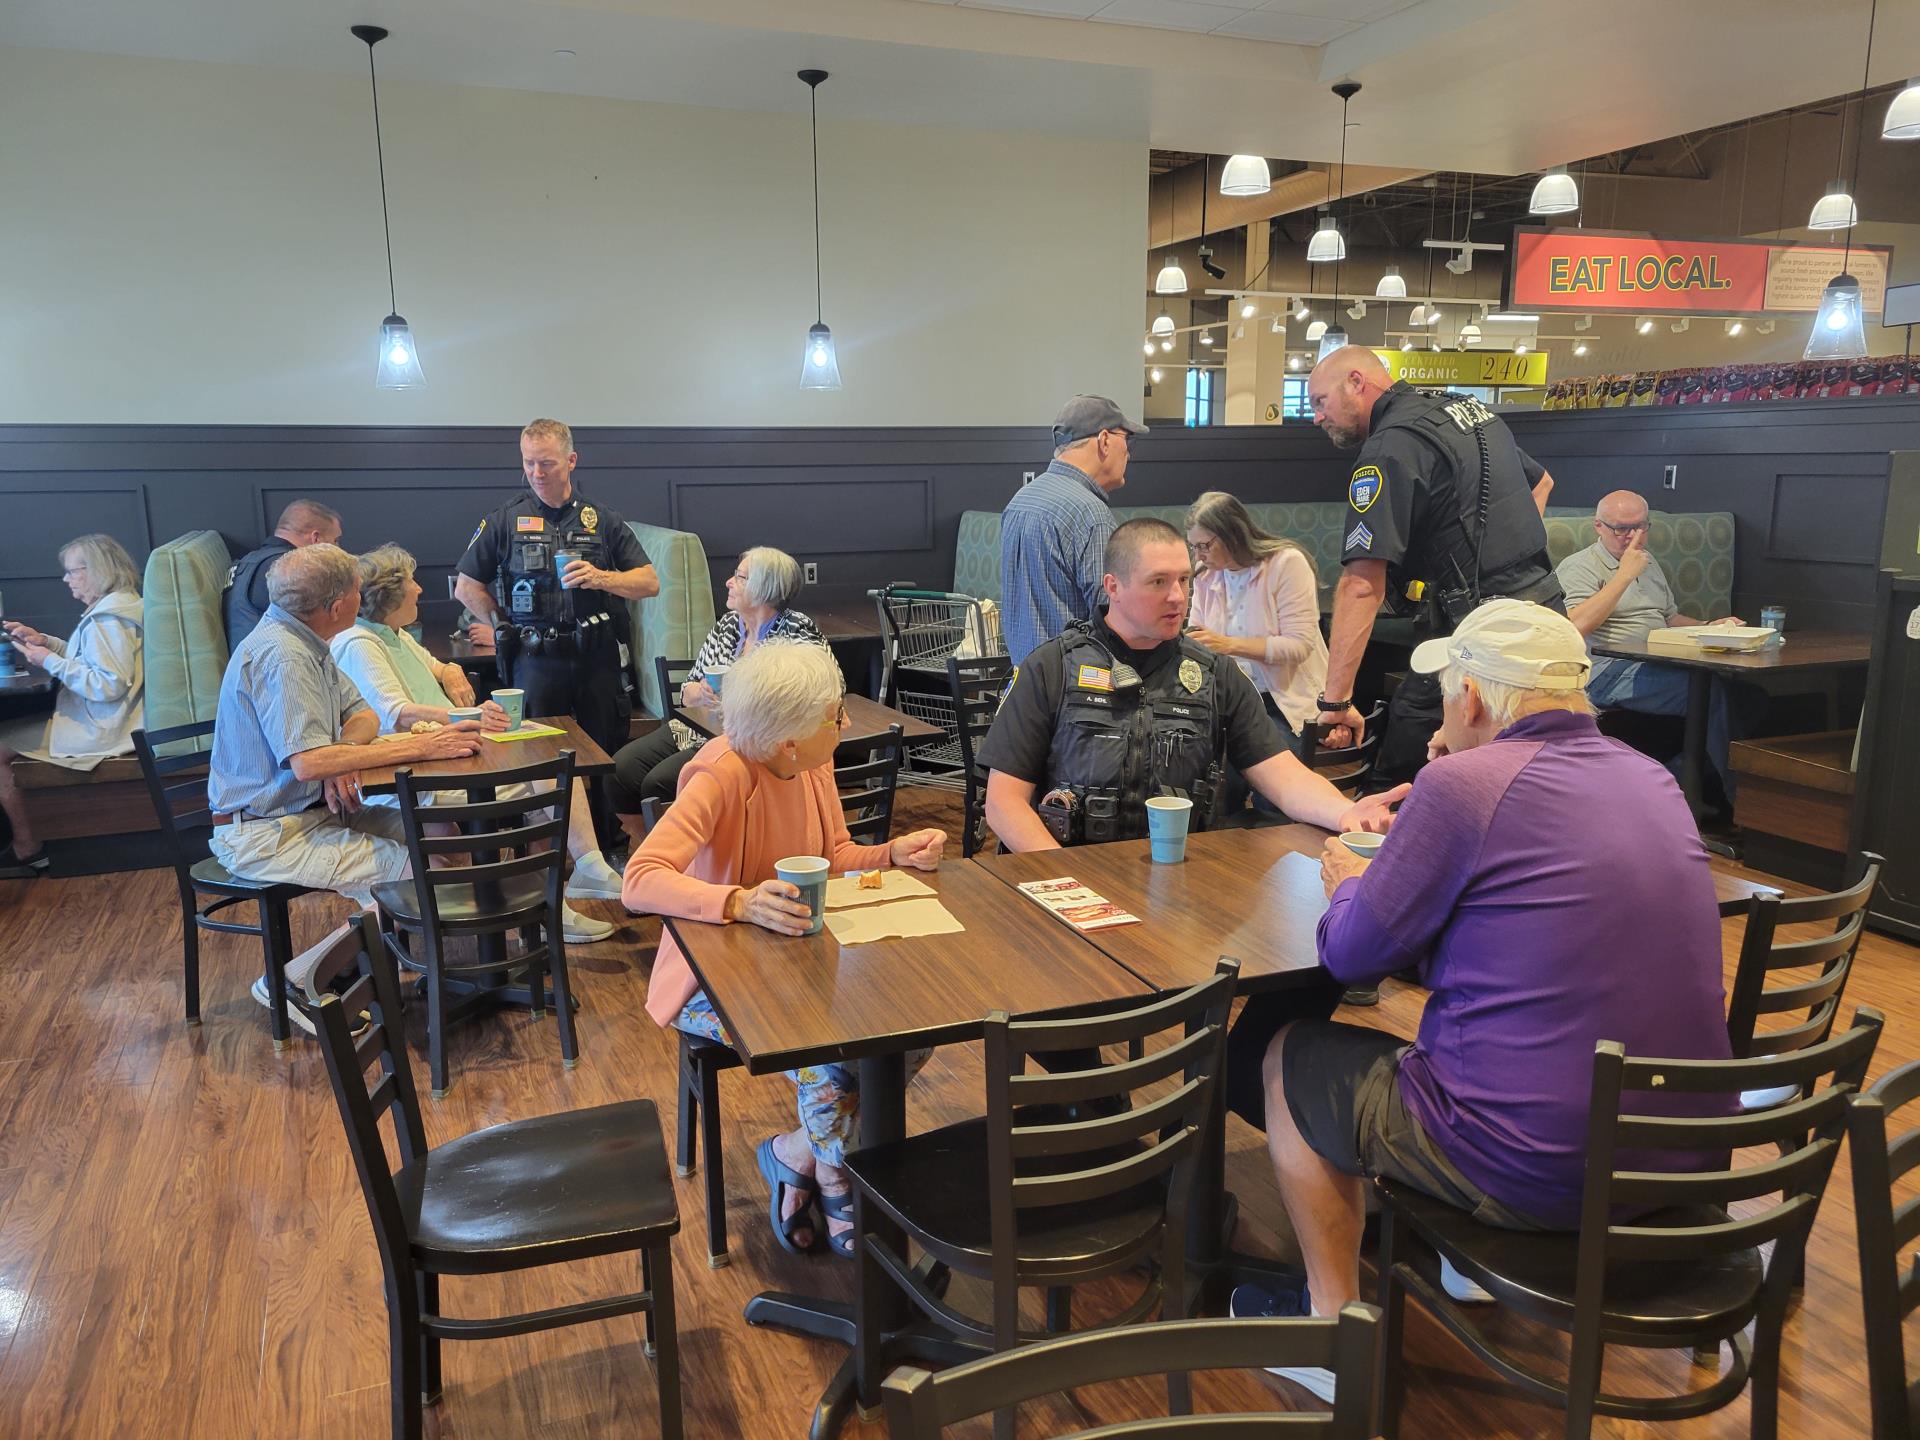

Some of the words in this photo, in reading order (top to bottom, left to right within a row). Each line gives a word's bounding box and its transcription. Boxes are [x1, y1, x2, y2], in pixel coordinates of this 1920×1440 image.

[1549, 256, 1613, 293] EAT
[1618, 255, 1734, 292] LOCAL.
[1404, 356, 1456, 366] CERTIFIED
[1482, 356, 1528, 380] 240
[1399, 367, 1459, 379] ORGANIC
